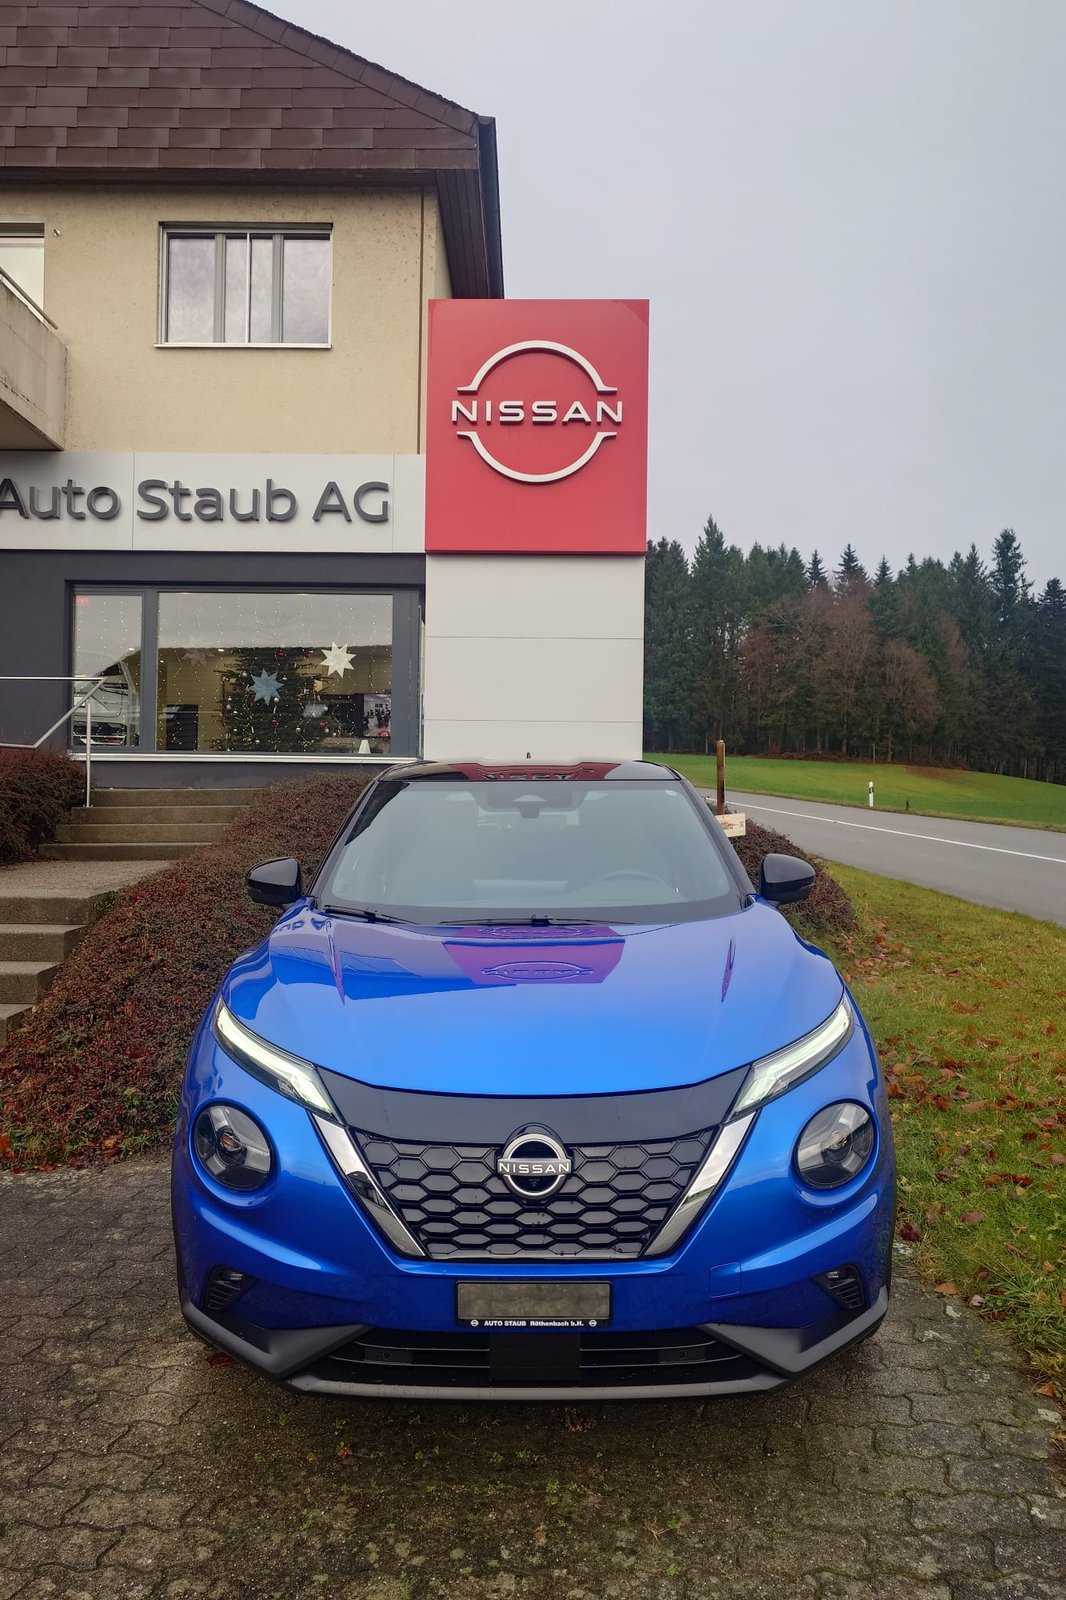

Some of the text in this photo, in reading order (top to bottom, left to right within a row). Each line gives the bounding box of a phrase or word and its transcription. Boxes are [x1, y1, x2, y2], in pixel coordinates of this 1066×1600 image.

[451, 400, 623, 424] NISSAN
[0, 478, 389, 522] Auto Staub AG
[499, 1163, 569, 1174] NISSAN
